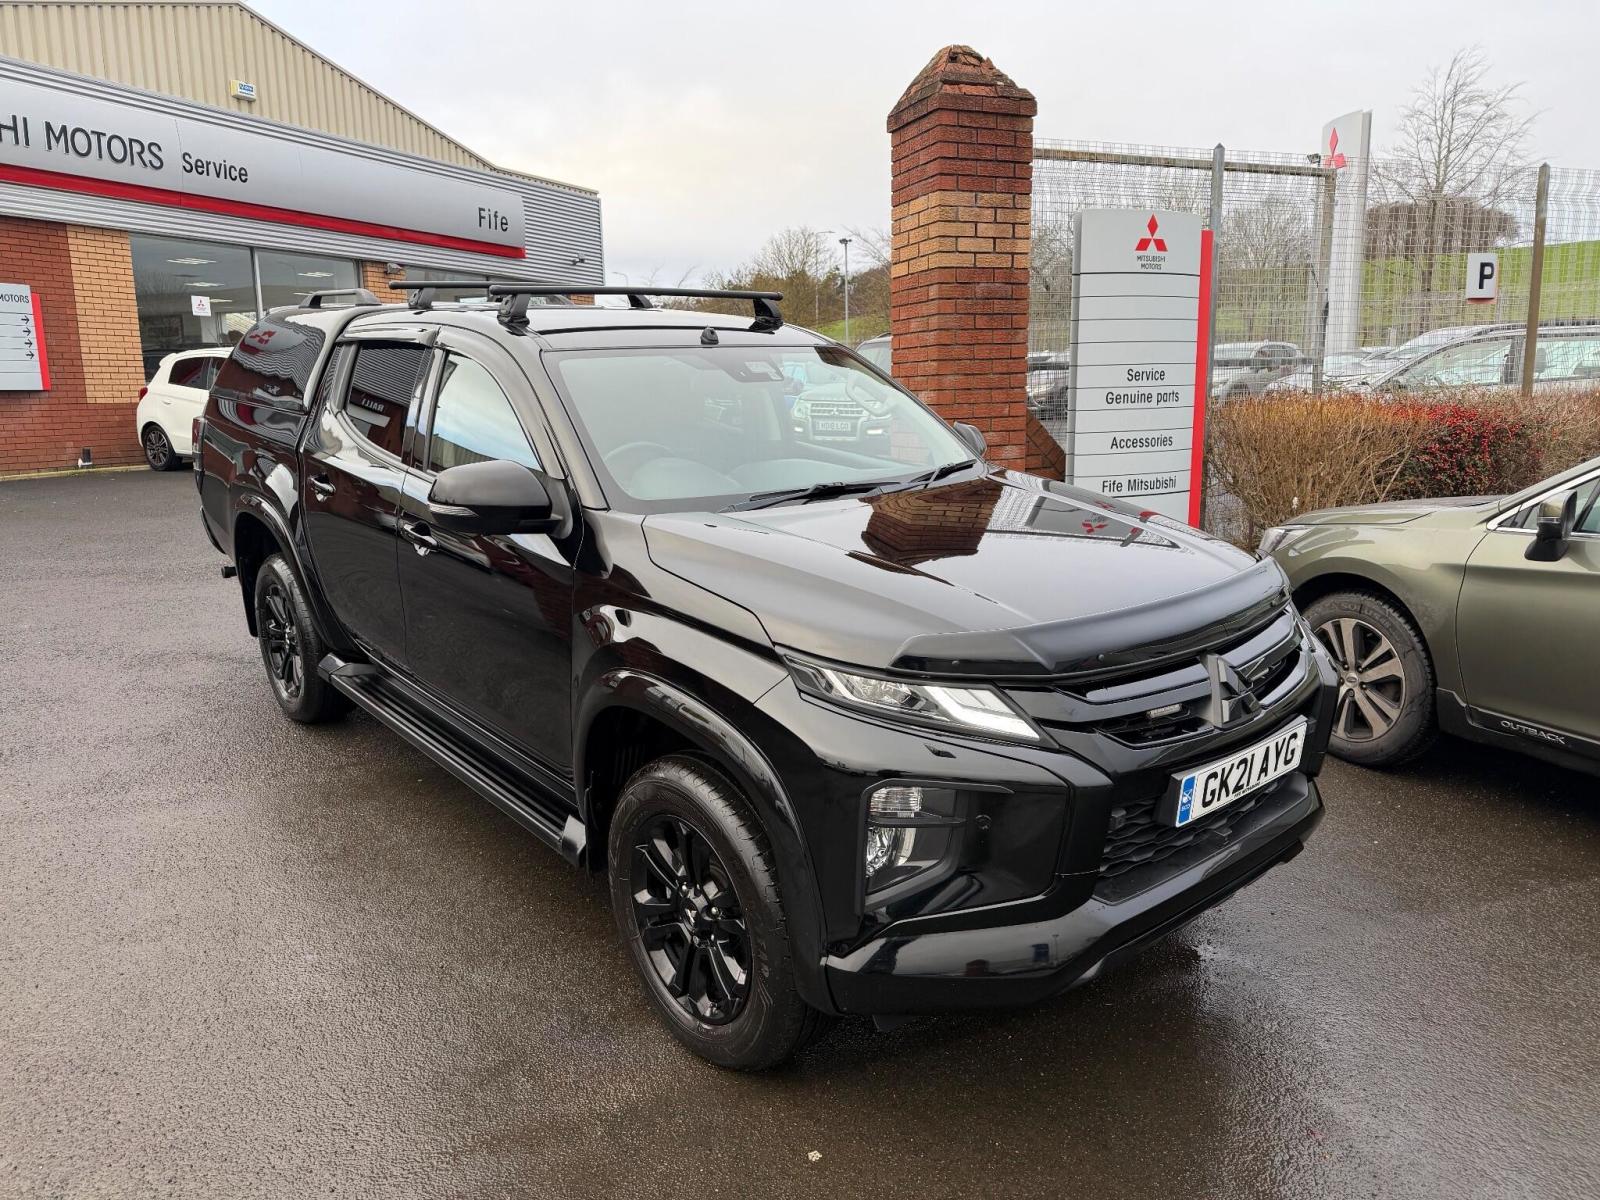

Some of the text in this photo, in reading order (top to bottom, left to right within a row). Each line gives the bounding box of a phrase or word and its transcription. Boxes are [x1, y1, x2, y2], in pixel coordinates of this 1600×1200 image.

[45, 121, 164, 170] MOTORS
[182, 152, 248, 183] Service
[478, 207, 508, 232] Fife
[1479, 262, 1495, 289] P
[1127, 368, 1165, 381] Service
[1106, 390, 1179, 405] Genuine parts
[1110, 434, 1173, 449] Accessories
[1102, 476, 1176, 492] Fife Mitsubishi
[1501, 721, 1565, 744] OUTBACK
[1202, 732, 1298, 808] GK21 AYG
